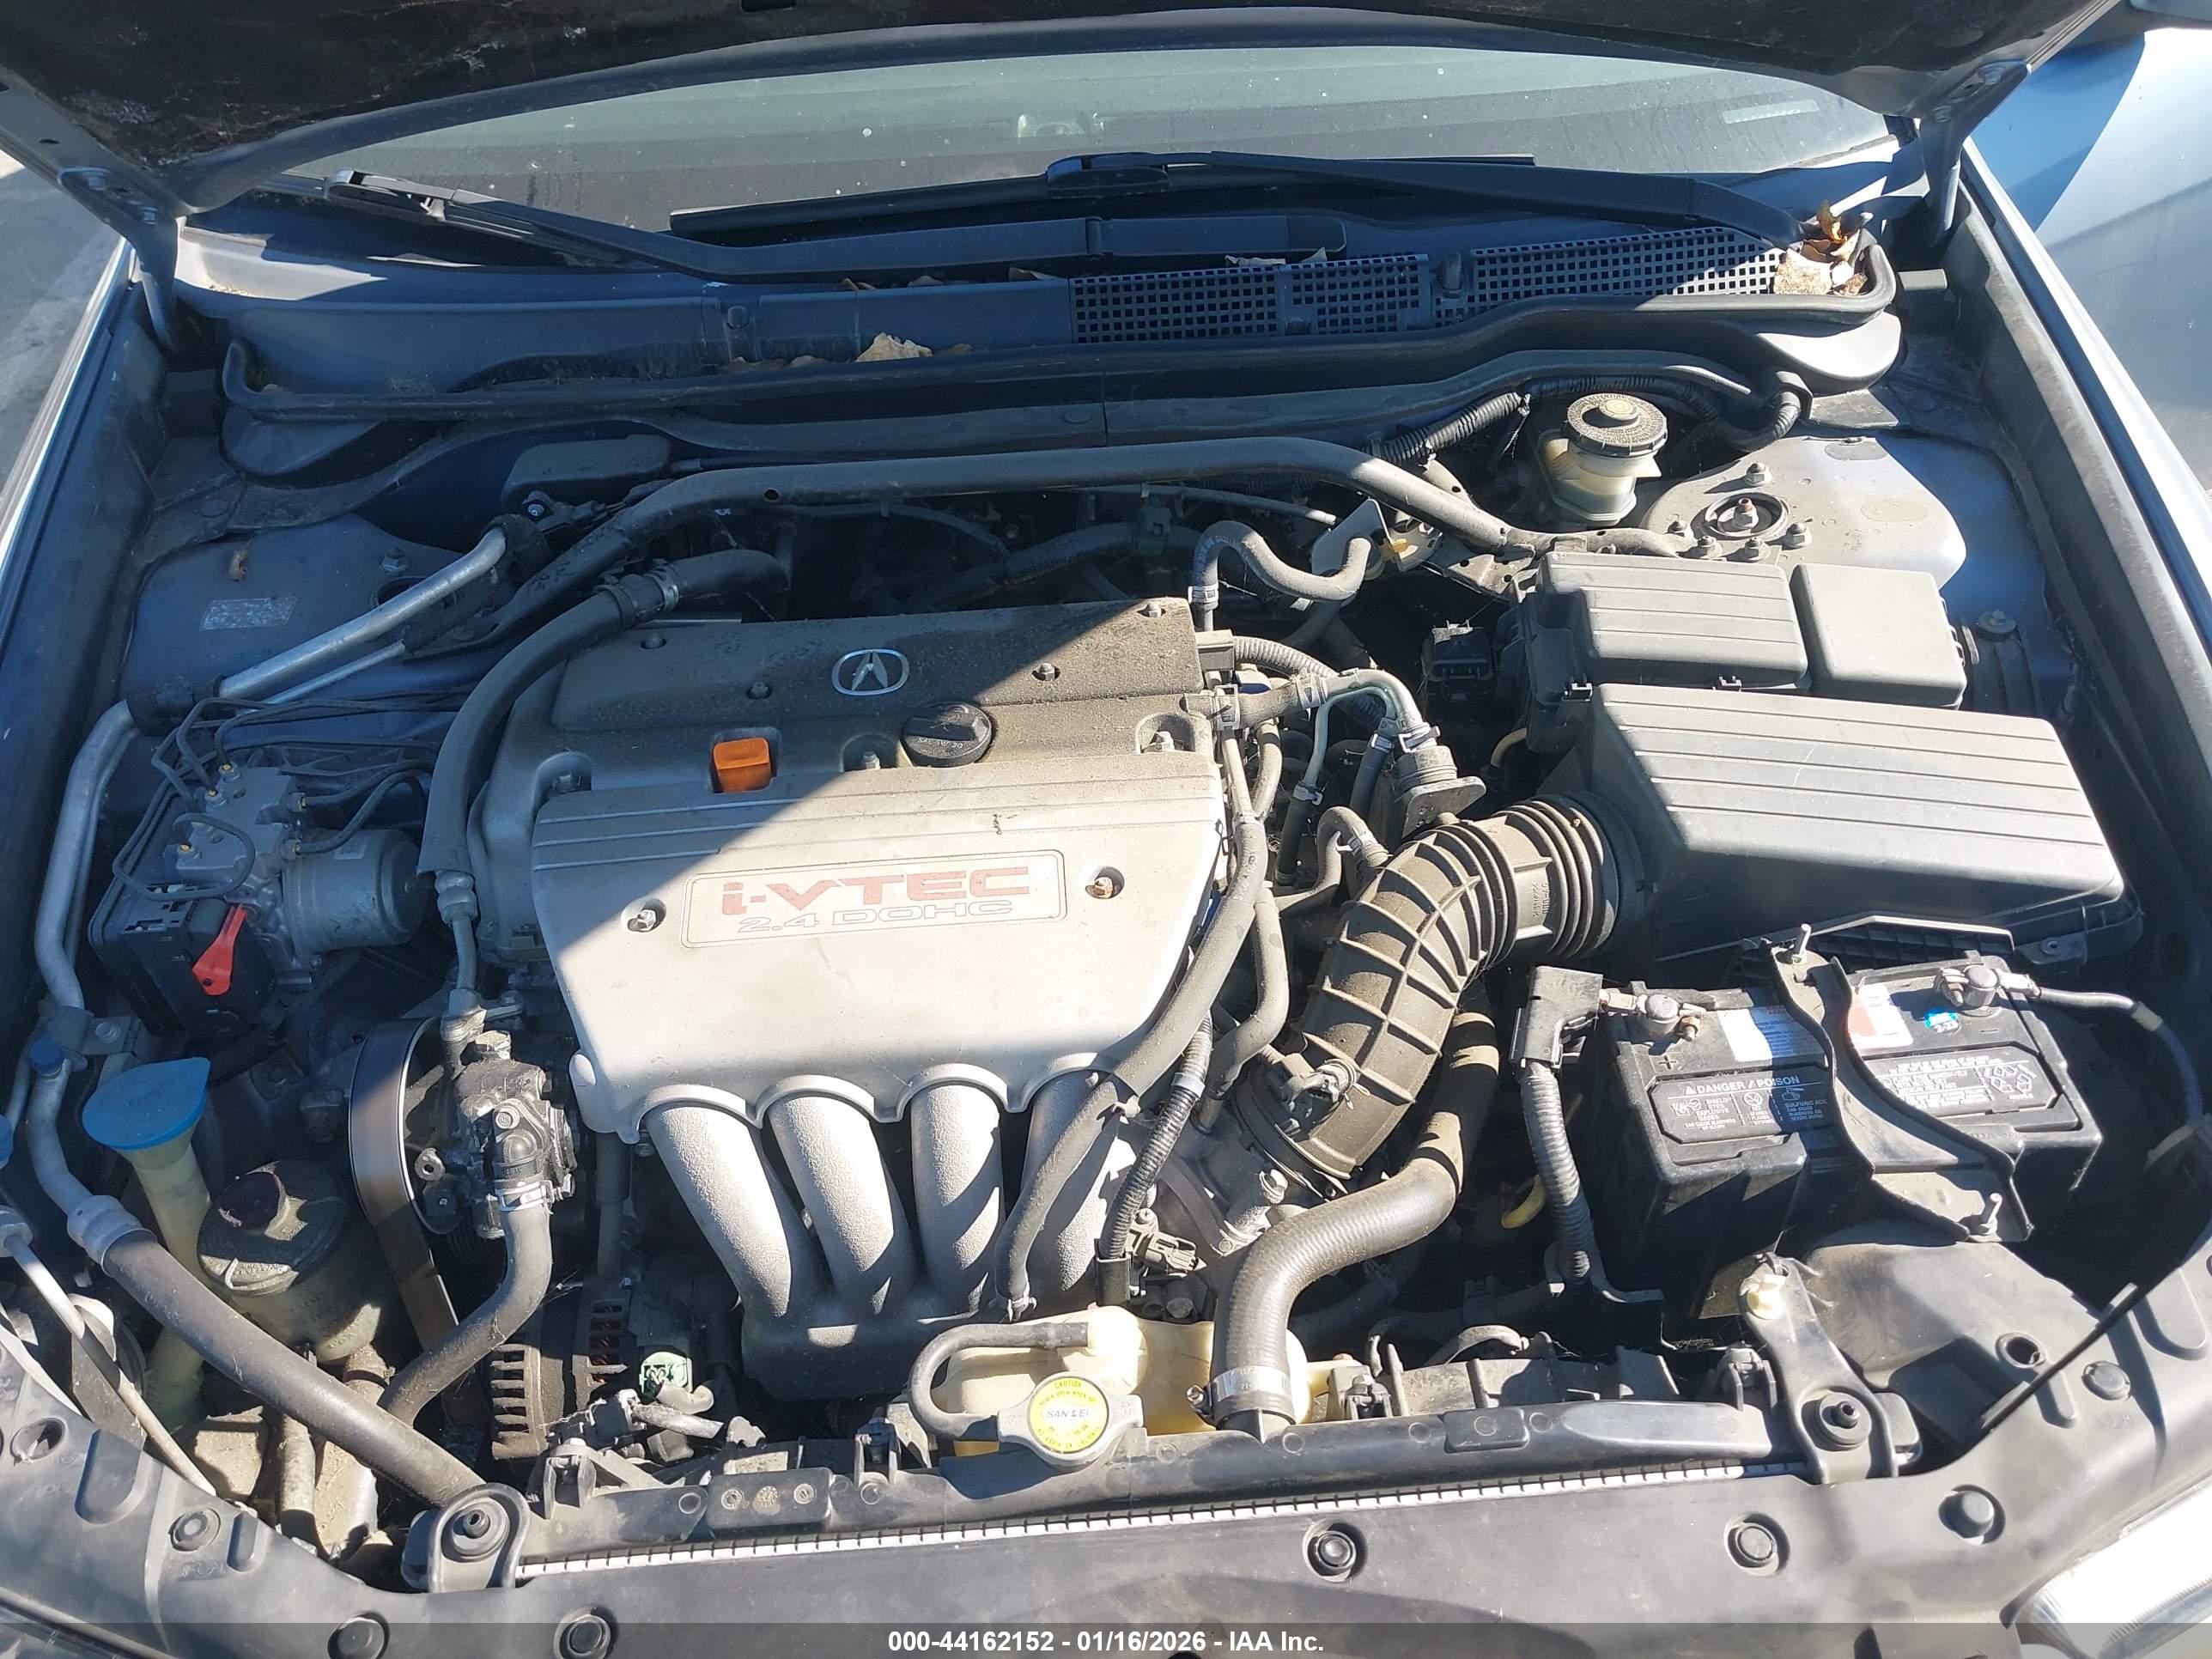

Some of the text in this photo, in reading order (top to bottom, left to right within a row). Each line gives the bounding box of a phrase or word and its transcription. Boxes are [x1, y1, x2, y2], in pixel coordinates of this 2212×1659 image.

[722, 866, 1029, 915] i-VTEC
[738, 900, 1013, 933] 2.4 DOHC
[1697, 1081, 1745, 1094] DANGER
[1756, 1075, 1801, 1088] POISON
